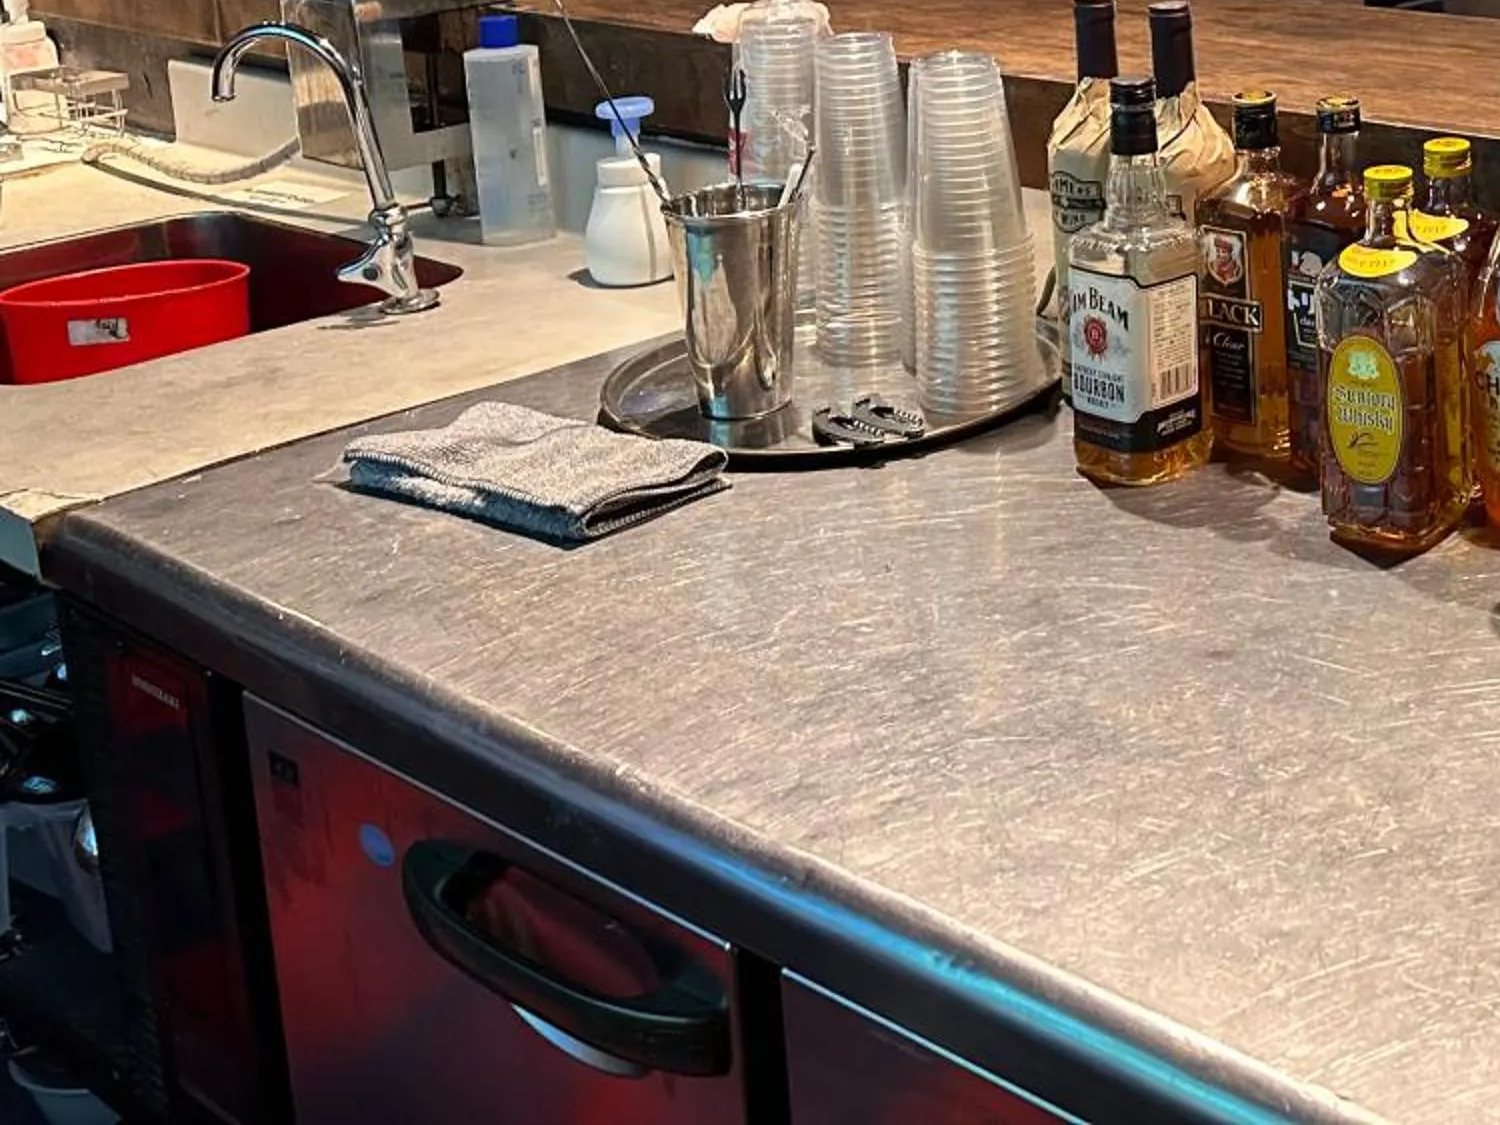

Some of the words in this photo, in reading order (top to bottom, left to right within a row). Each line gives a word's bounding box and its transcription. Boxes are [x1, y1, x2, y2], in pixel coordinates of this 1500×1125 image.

[1089, 286, 1129, 331] BEAM
[1206, 298, 1259, 328] LACK
[1336, 385, 1396, 411] Suntory
[1337, 405, 1394, 431] Whisky
